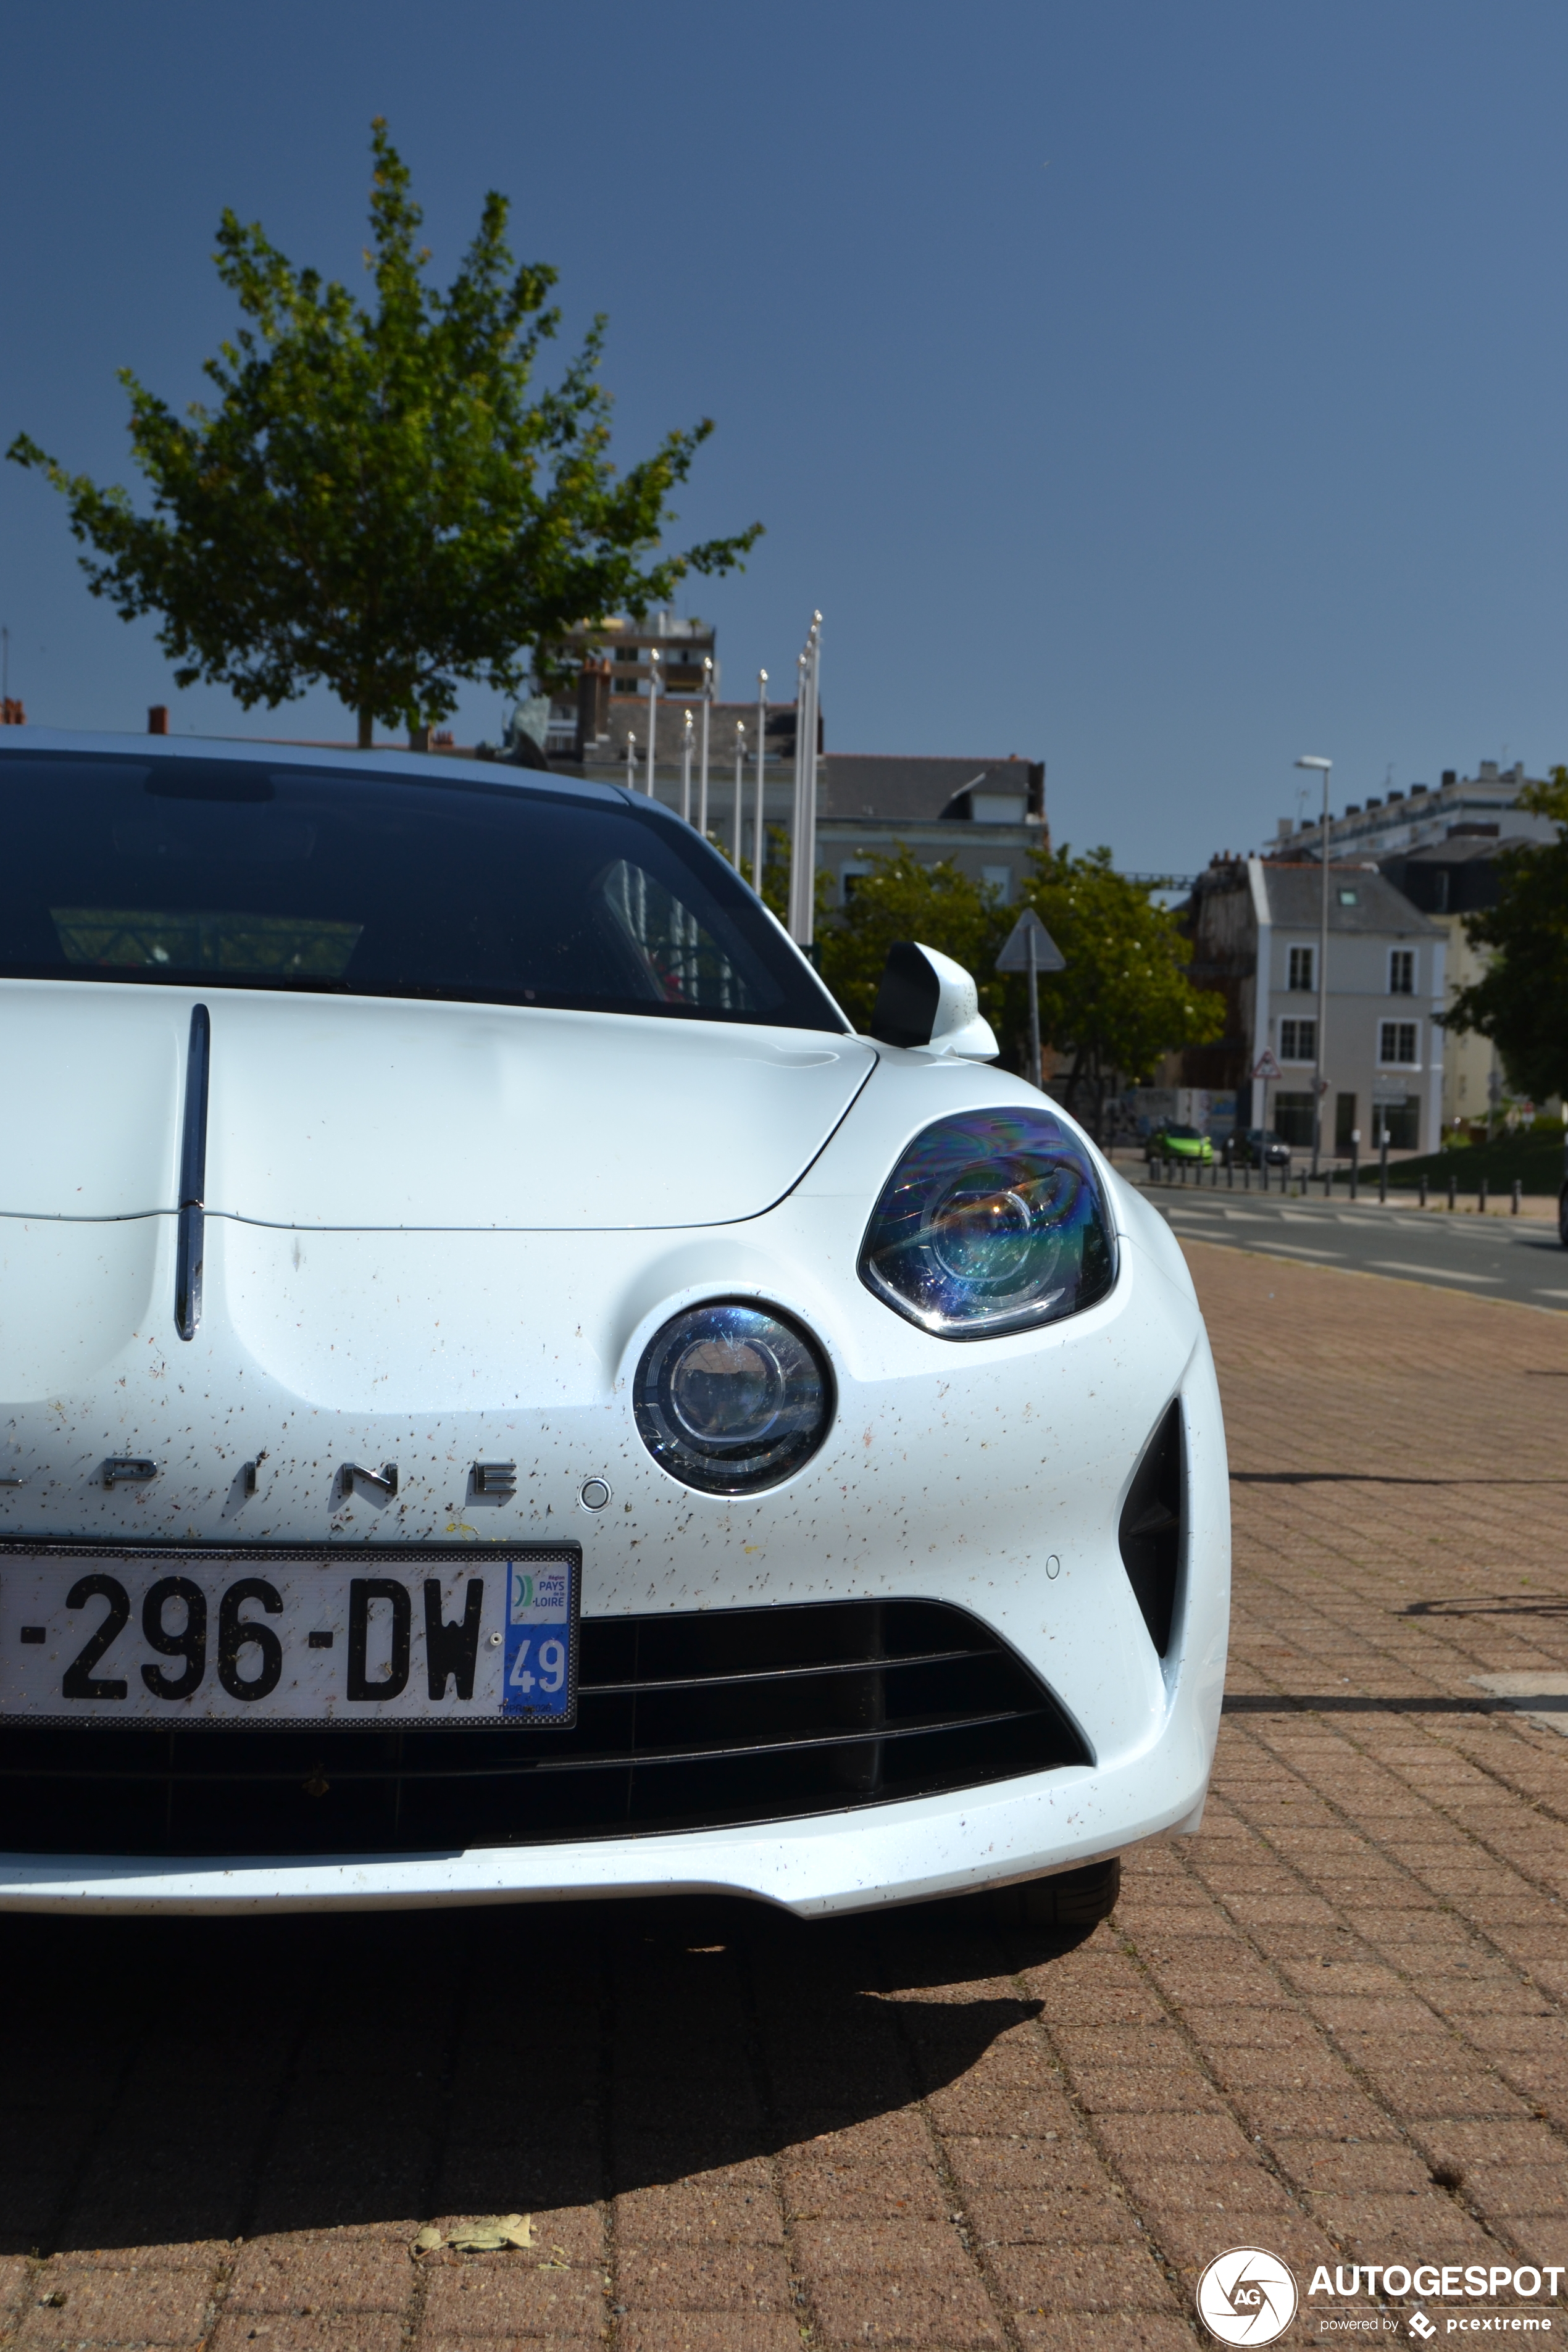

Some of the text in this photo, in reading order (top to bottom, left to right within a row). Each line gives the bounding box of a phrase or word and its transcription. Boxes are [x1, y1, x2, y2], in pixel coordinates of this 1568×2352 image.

[0, 1457, 517, 1495] PINE
[540, 1581, 564, 1591] PAYS
[535, 1597, 564, 1607] LOIRE
[509, 1640, 565, 1693] 49
[497, 1704, 552, 1713] TPPR 026
